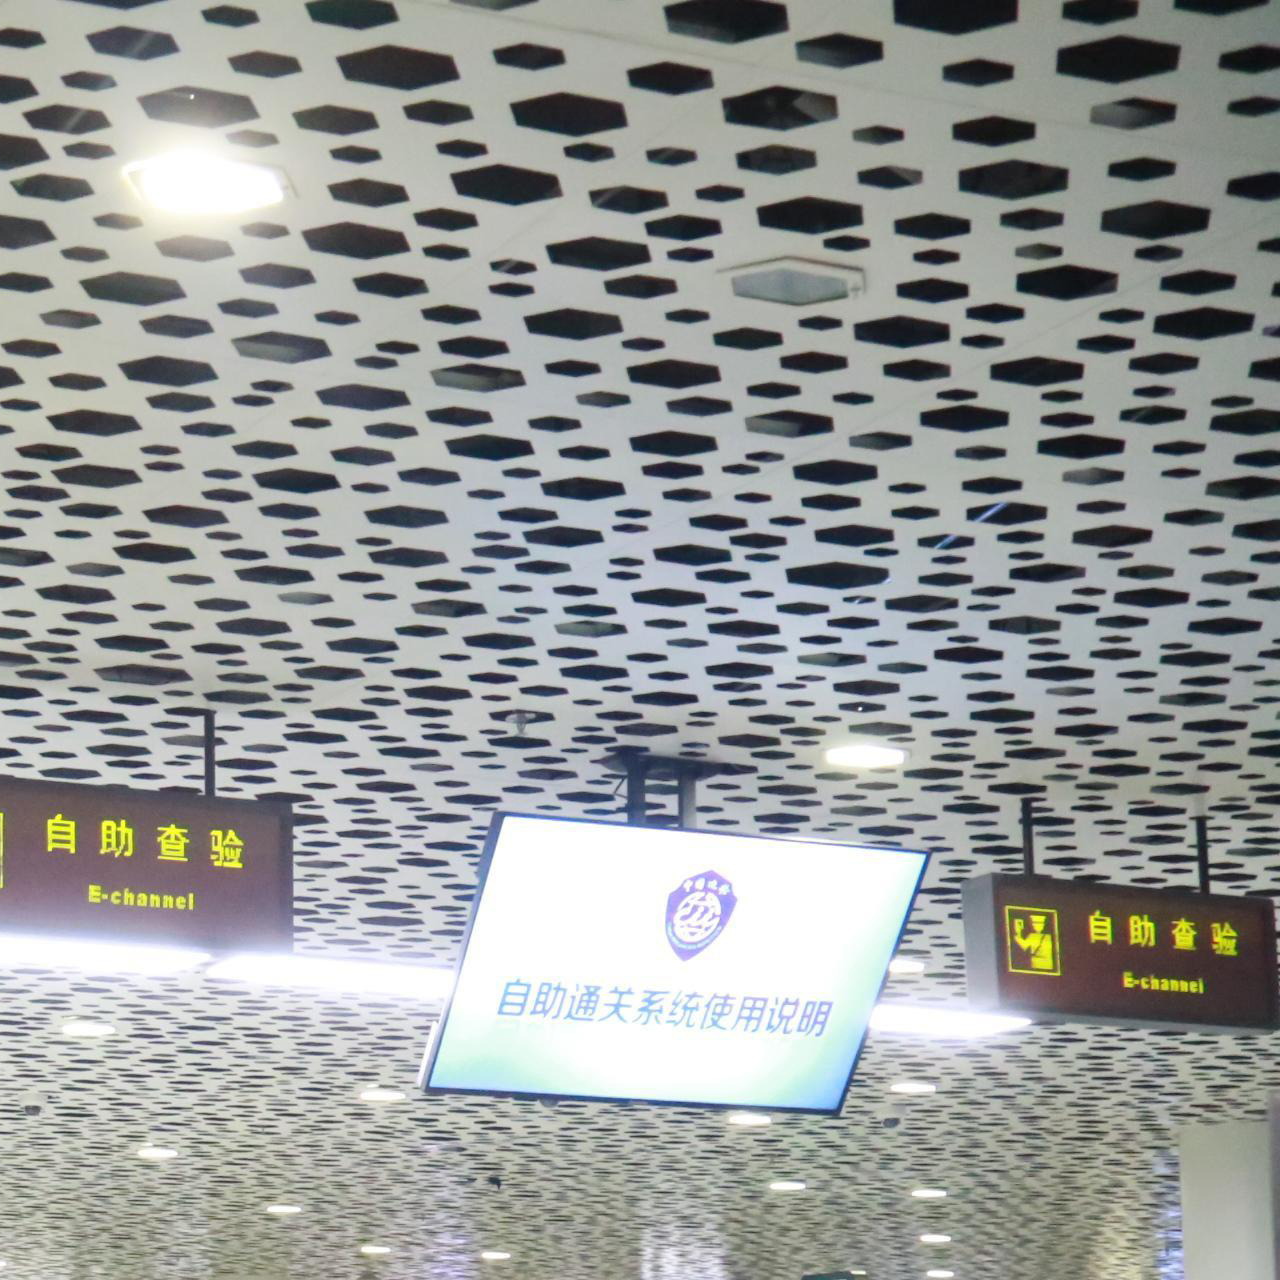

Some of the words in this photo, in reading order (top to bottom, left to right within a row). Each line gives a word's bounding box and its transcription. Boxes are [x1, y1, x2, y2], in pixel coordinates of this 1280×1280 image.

[46, 813, 245, 869] 自助查验
[88, 884, 195, 911] E-channel
[1088, 909, 1238, 957] 自助查验
[1122, 971, 1204, 995] E-channel
[496, 978, 834, 1038] 自助通关系统使用说明
